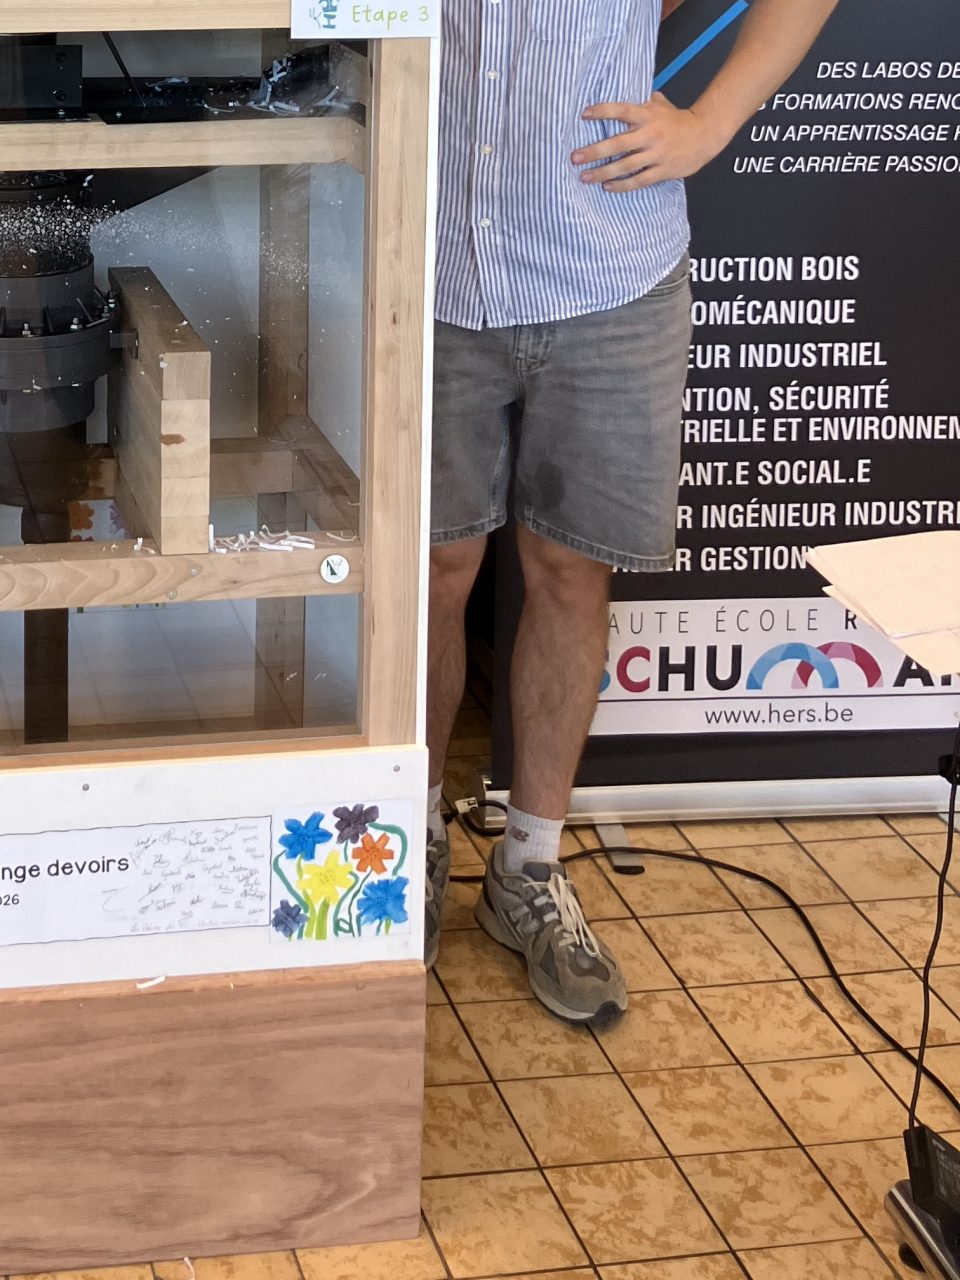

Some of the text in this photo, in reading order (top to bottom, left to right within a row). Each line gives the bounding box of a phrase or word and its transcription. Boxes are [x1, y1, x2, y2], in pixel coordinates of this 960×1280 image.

[352, 4, 429, 31] Etape 3
[817, 62, 857, 78] DES
[862, 62, 932, 78] LABOS
[772, 93, 904, 110] FORMATIONS
[751, 126, 781, 141] UN
[783, 125, 950, 141] APPRENTISSAGE
[733, 152, 960, 173] UNE CARRIÈRE PASSIO
[688, 256, 859, 282] RUCTION BOIS
[691, 295, 855, 325] OMÉCANIQUE
[739, 342, 887, 368] INDUSTRIEL
[769, 378, 889, 410] SÉCURITÉ
[681, 418, 766, 443] RIELLE
[773, 418, 802, 441] ET
[678, 459, 871, 486] ANT.E SOCIAL.E
[702, 498, 836, 528] INGÉNIEUR
[609, 612, 689, 635] AUTE
[716, 606, 819, 633] ÉCOLE
[705, 701, 854, 724] www.hers.be
[47, 856, 130, 876] devoirs
